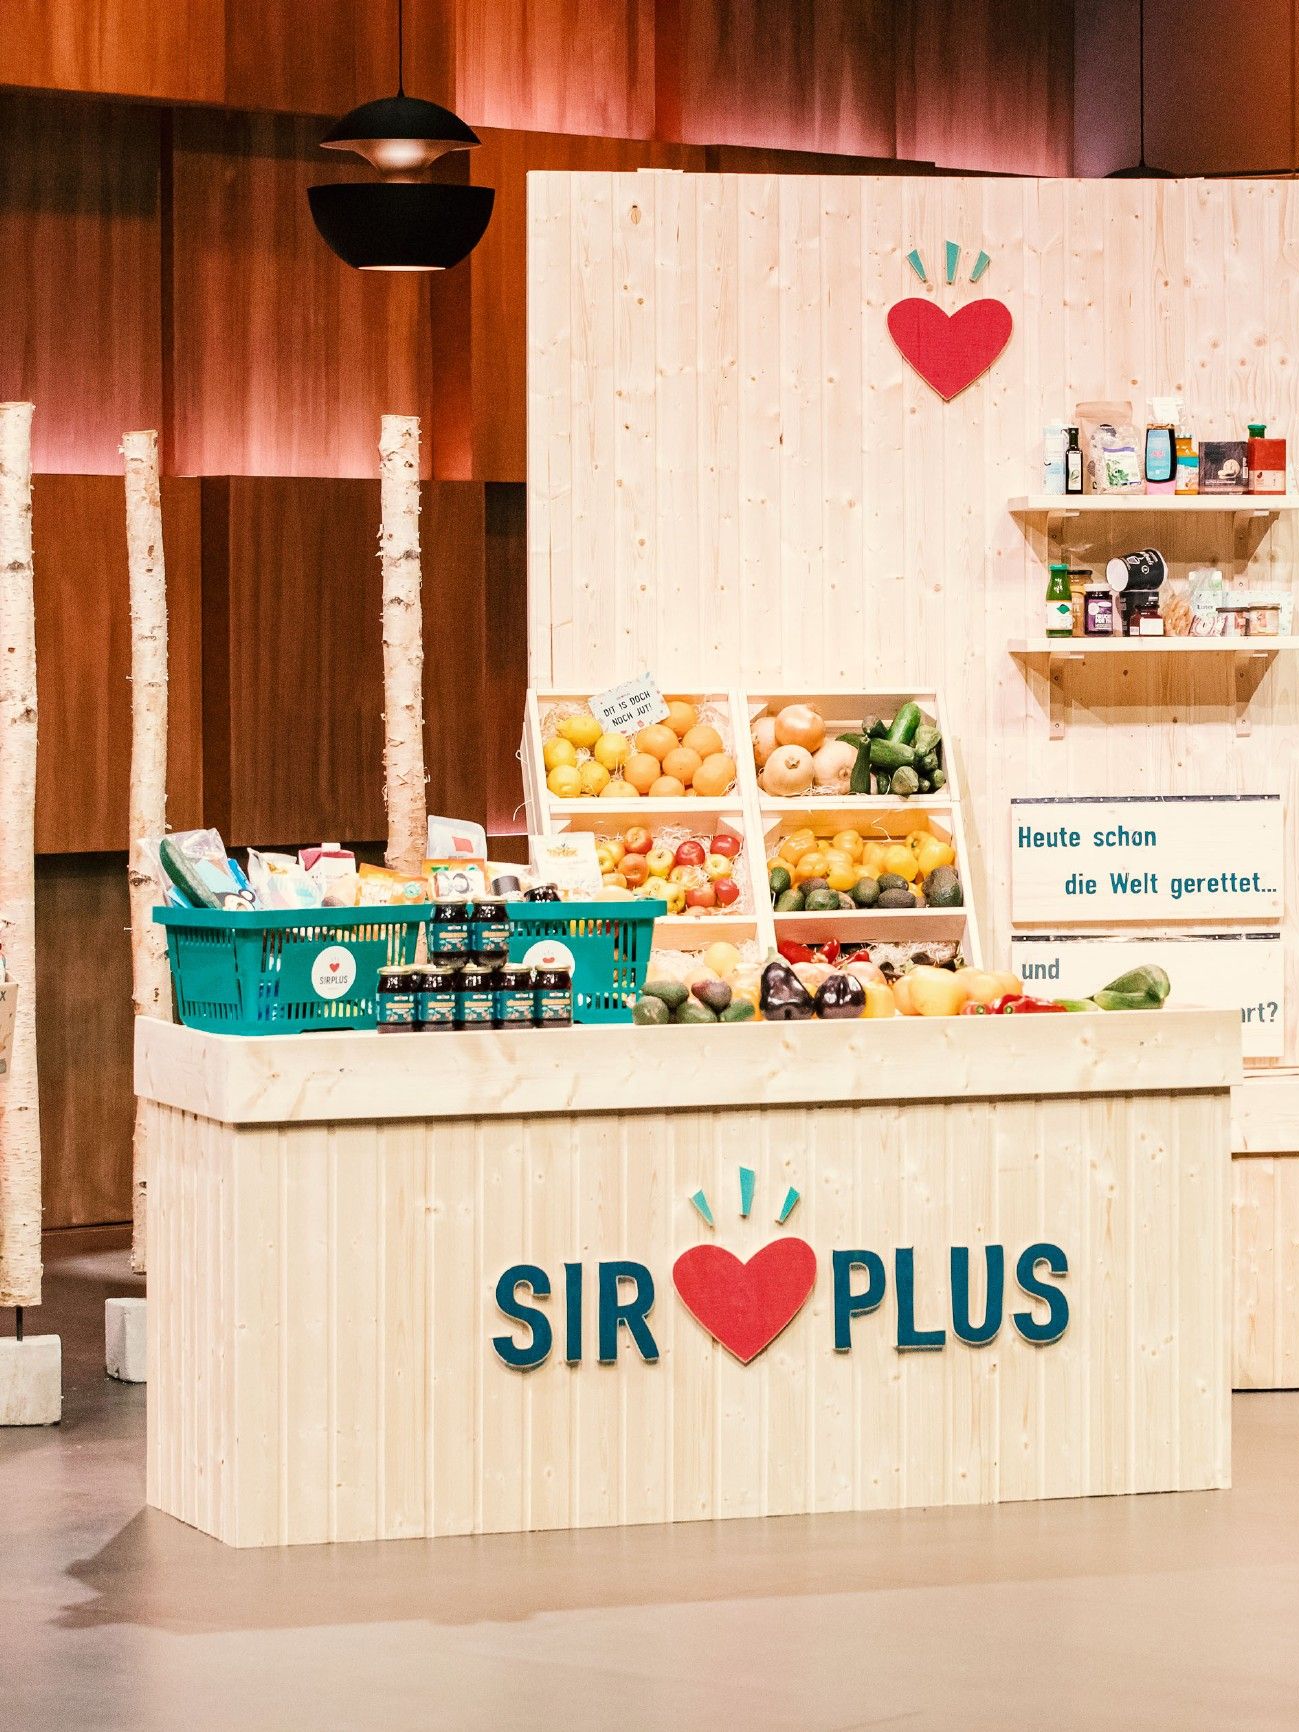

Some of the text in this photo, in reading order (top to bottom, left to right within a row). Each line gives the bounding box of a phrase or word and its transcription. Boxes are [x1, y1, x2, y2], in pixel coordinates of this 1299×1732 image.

[603, 706, 616, 717] DIT
[619, 701, 628, 710] IS
[629, 690, 651, 706] DOCH
[612, 702, 653, 727] NOCH JUT!
[1018, 825, 1157, 848] Heute schon
[1065, 872, 1277, 899] die Welt gerettet...
[319, 975, 348, 985] SIRPLUS
[1021, 958, 1060, 980] und
[491, 1242, 1070, 1371] SIR PLUS
